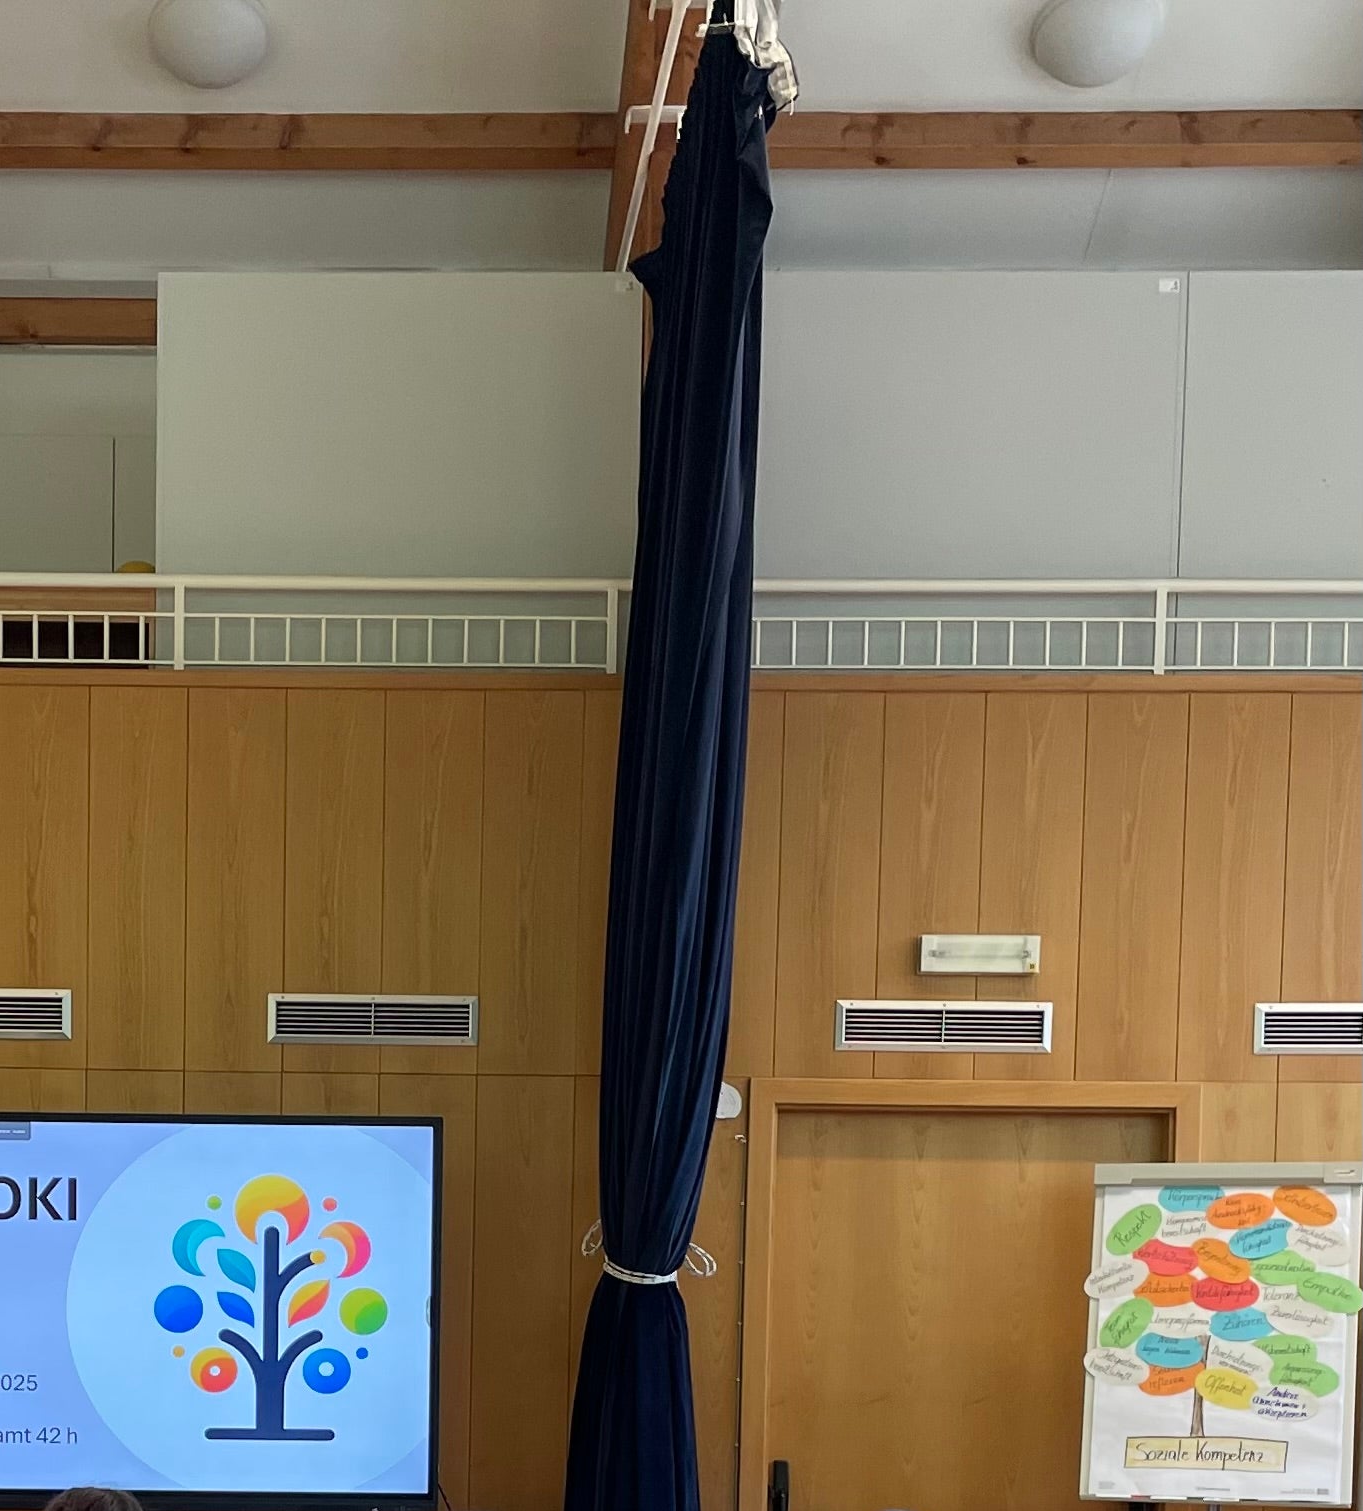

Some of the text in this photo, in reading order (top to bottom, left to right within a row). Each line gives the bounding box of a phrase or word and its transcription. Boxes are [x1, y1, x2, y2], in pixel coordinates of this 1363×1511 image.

[36, 1426, 62, 1445] 42
[67, 1427, 78, 1445] h
[1134, 1438, 1264, 1470] Soziale Kompetenz
